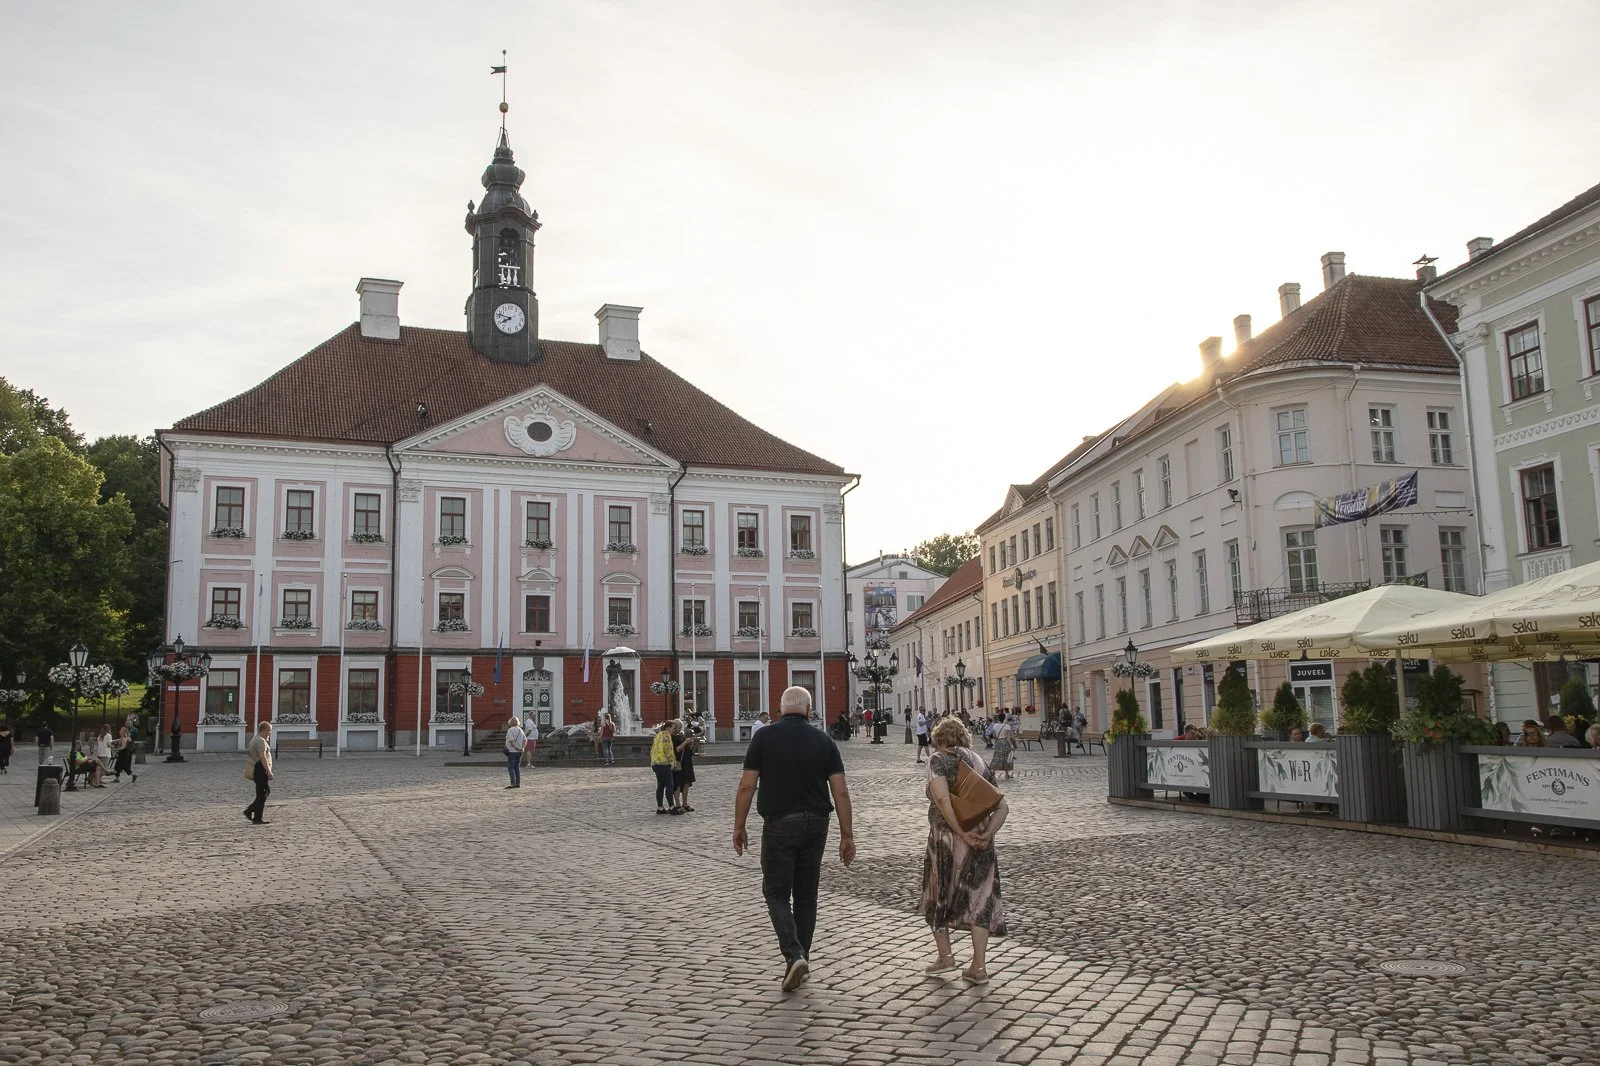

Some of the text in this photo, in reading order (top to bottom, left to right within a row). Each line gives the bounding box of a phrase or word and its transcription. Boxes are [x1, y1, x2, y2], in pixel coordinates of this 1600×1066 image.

[1512, 618, 1538, 634] saku
[1578, 612, 1600, 628] sak
[1397, 632, 1419, 645] saku
[1451, 625, 1476, 639] saku
[1228, 644, 1242, 655] saku
[1261, 640, 1276, 652] saku
[1297, 637, 1313, 649] saku
[1196, 648, 1209, 658] saku
[1297, 668, 1326, 676] JUVEEL
[1289, 760, 1312, 782] W&R
[1526, 768, 1590, 787] FENTIMANS
